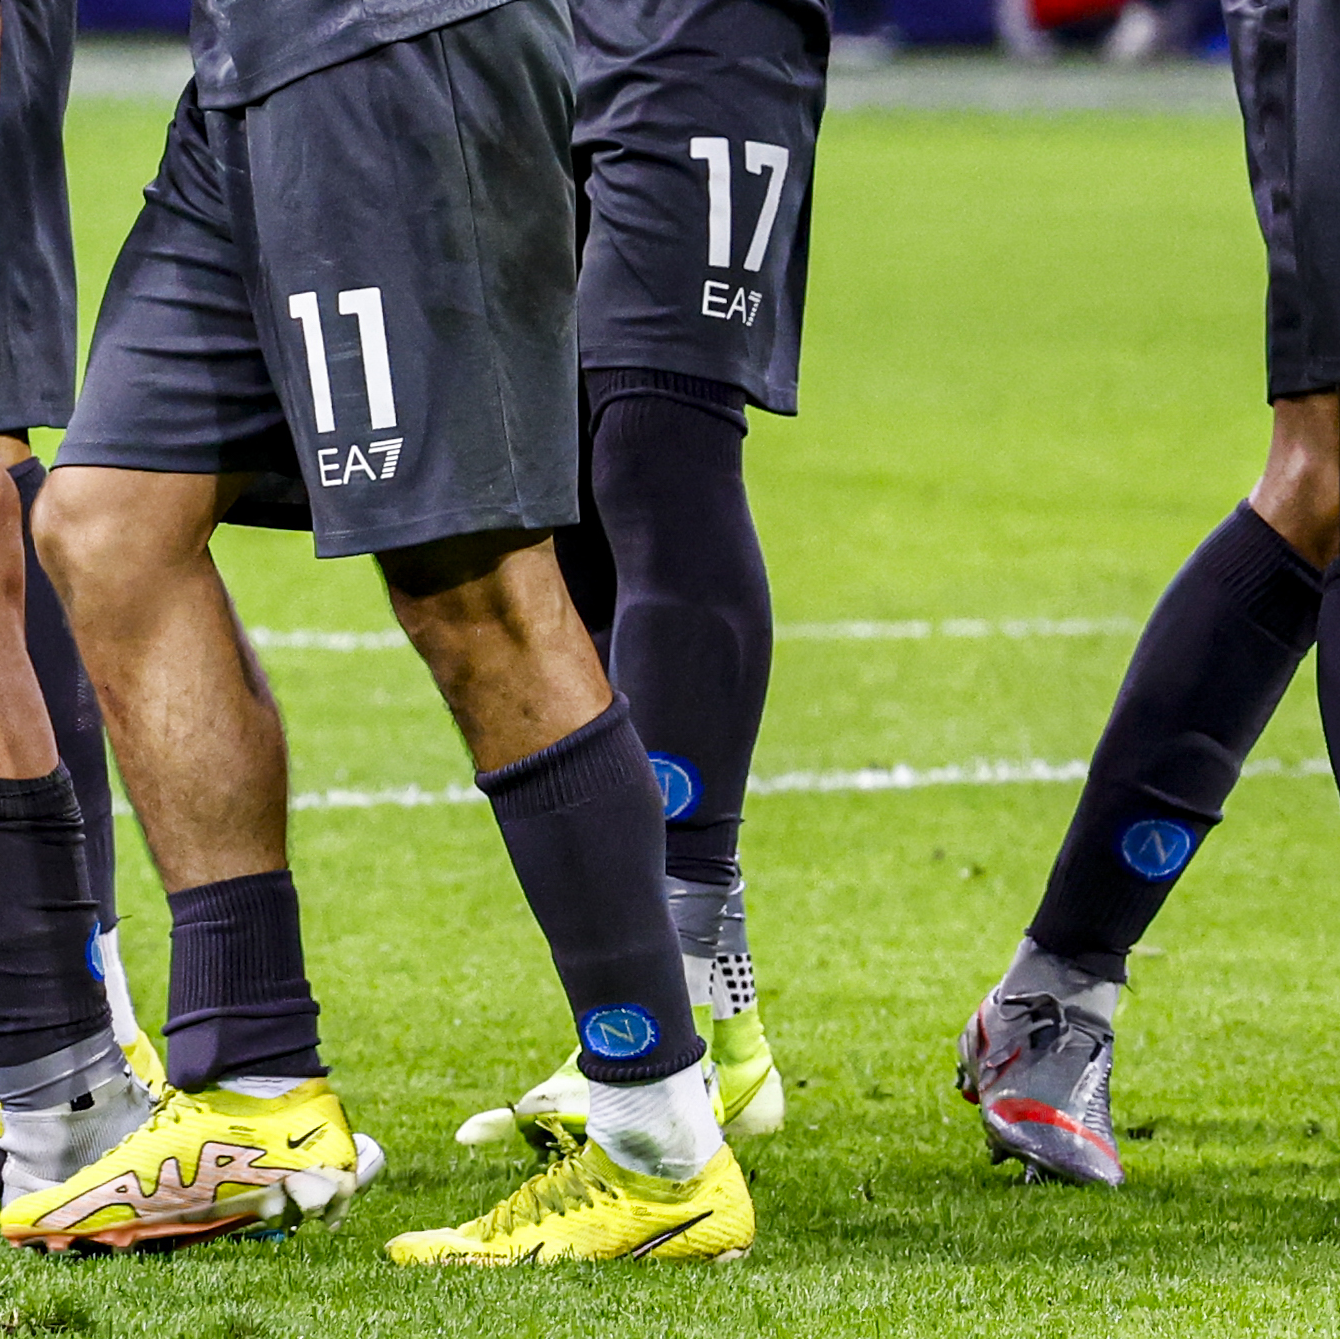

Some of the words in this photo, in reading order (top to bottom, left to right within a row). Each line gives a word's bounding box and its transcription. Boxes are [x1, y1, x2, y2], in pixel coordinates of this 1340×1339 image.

[690, 136, 790, 273] 17
[288, 286, 397, 434] 11
[317, 437, 404, 487] EA7
